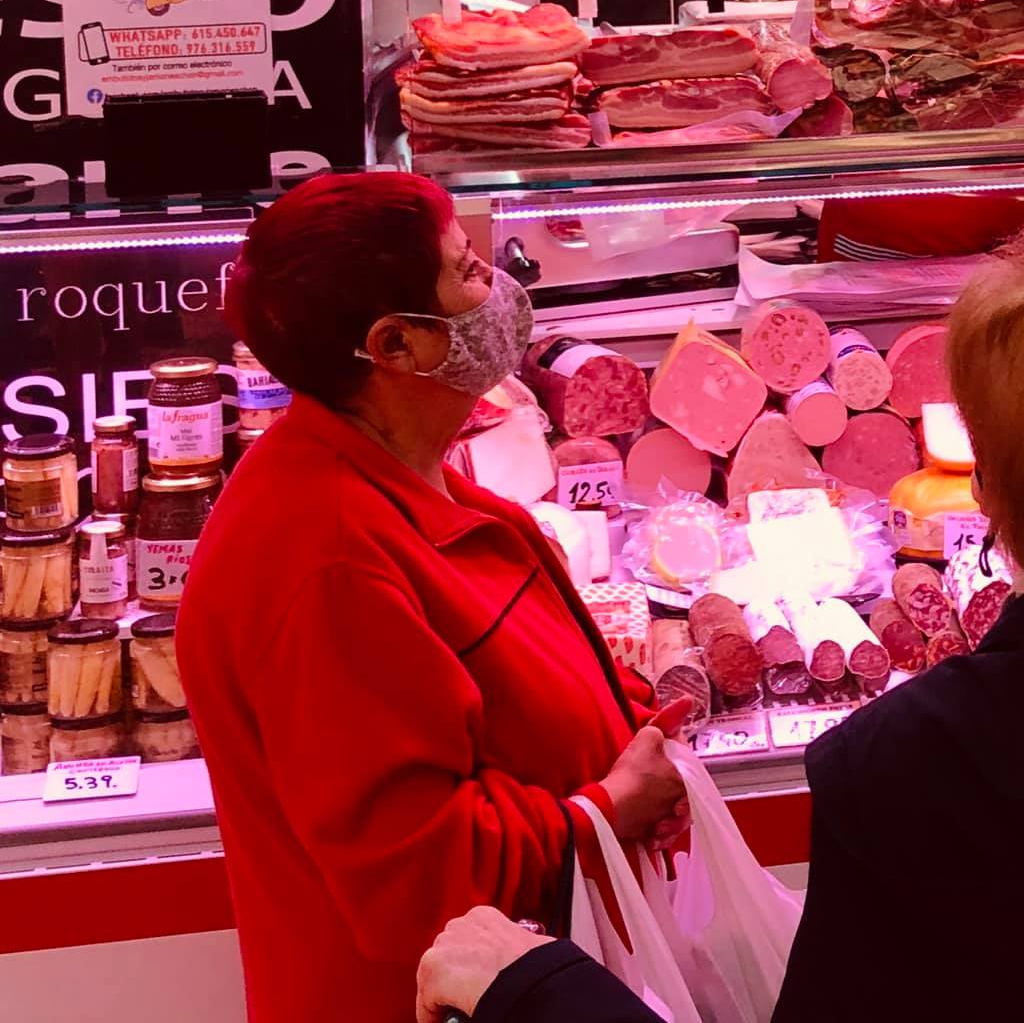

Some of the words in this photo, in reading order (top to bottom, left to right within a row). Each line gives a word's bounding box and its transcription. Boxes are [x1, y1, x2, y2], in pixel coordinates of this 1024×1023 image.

[112, 64, 146, 73] También
[148, 64, 161, 73] por
[147, 544, 184, 554] YEMAS
